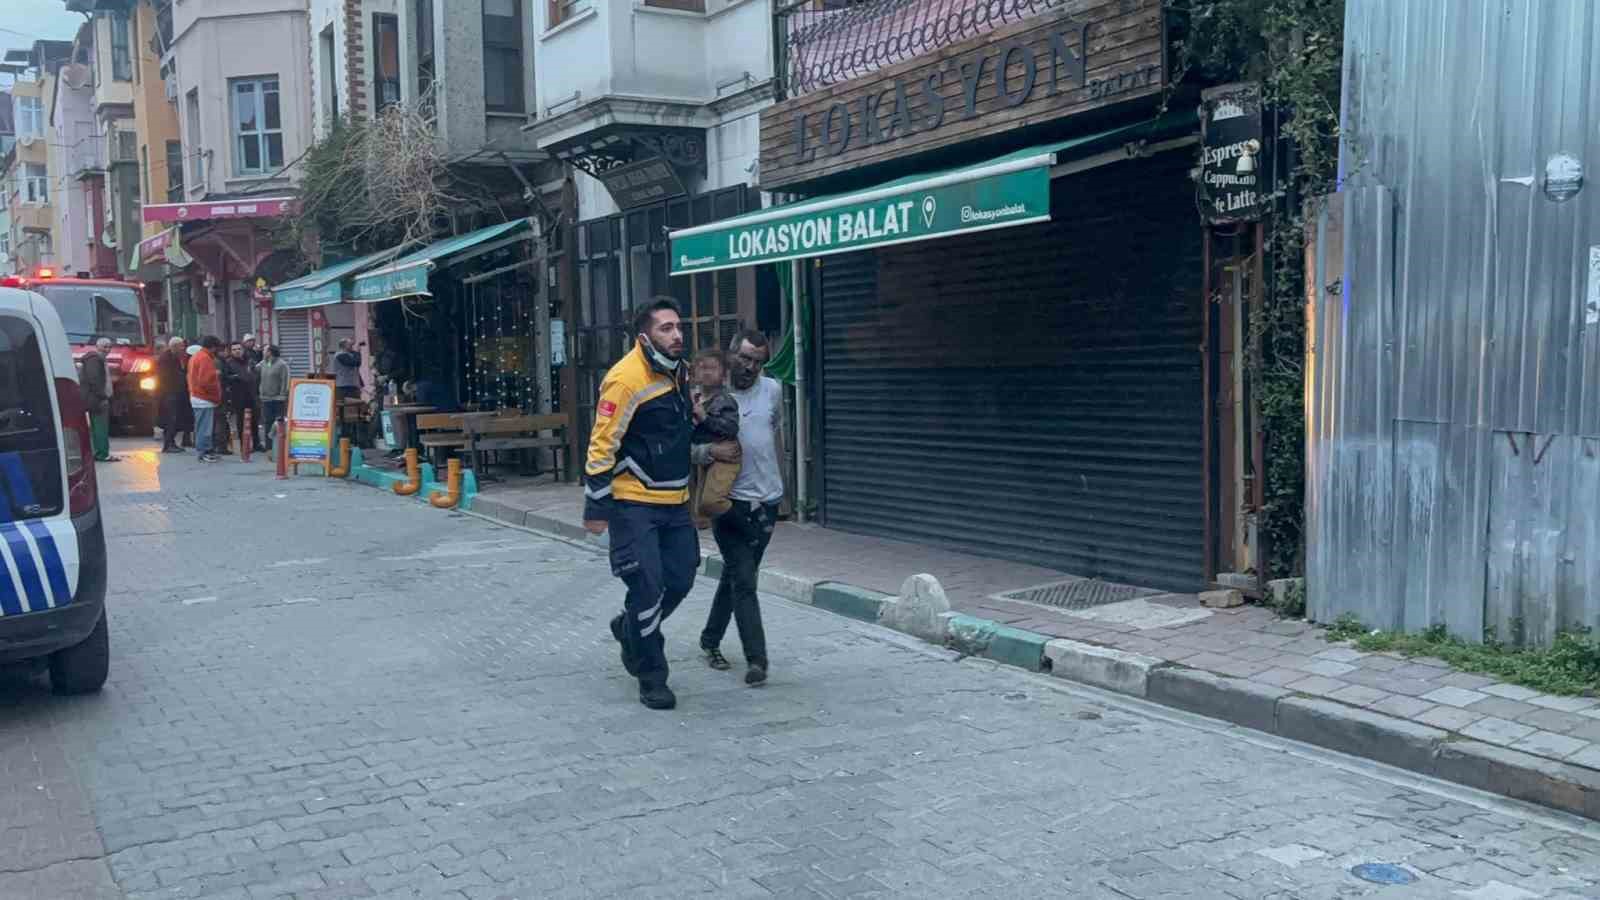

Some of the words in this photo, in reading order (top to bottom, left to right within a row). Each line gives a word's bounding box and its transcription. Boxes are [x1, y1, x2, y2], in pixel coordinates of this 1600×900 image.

[792, 20, 1092, 165] LOKASYON
[1203, 140, 1251, 168] Espres
[1226, 189, 1257, 211] Latte
[728, 218, 832, 260] LOKASYON
[838, 201, 913, 242] BALAT
